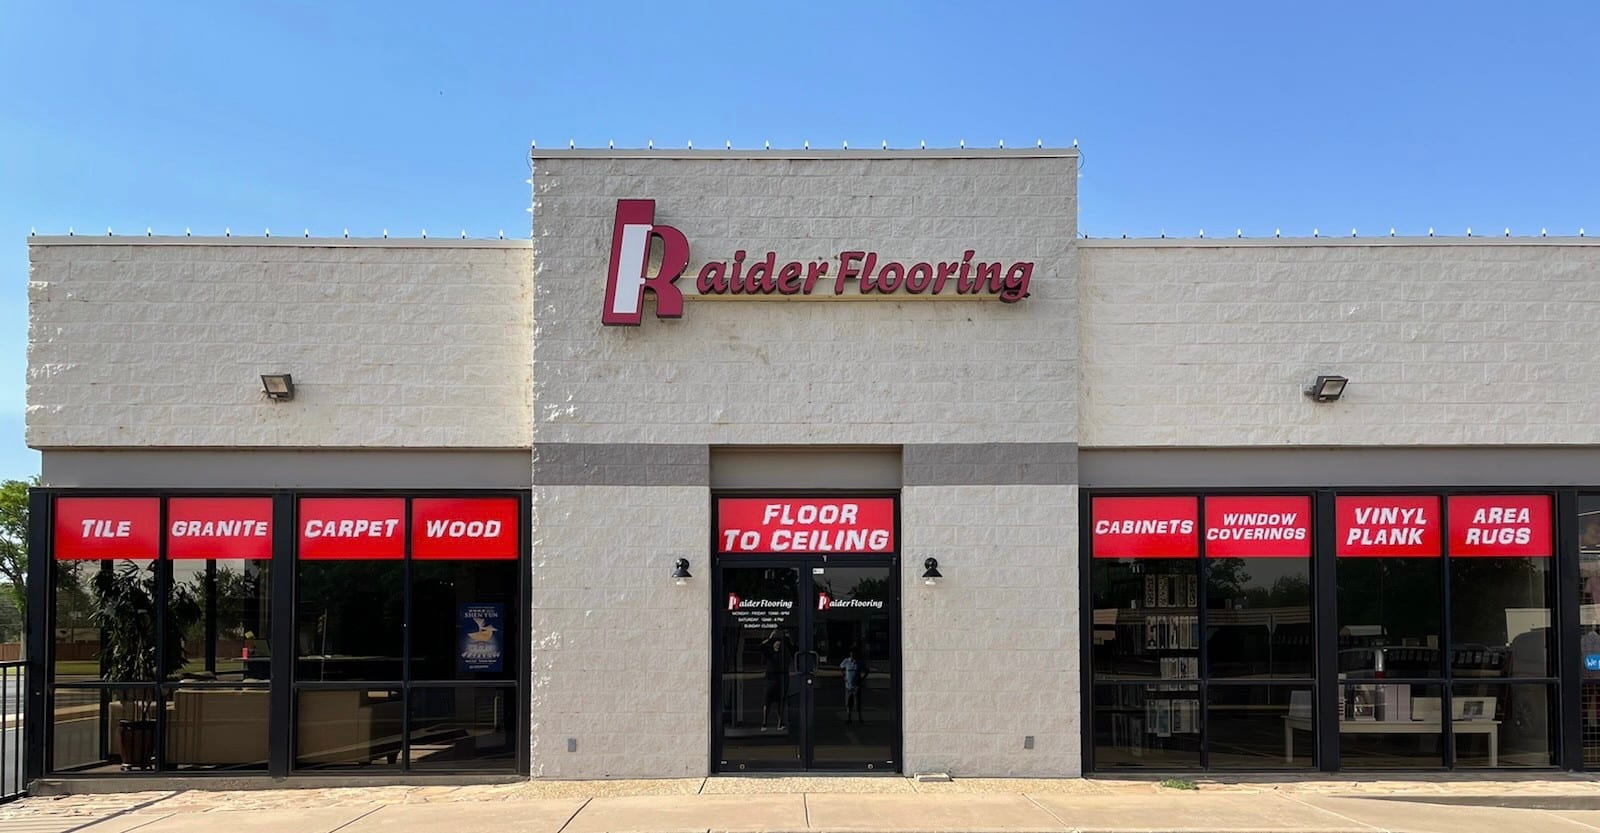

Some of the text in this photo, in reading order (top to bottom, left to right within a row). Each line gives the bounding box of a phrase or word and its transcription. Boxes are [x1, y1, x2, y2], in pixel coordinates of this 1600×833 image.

[601, 198, 1034, 327] Raider Flooring
[762, 503, 858, 525] FLOOR
[1223, 512, 1297, 526] WINDOW
[1355, 507, 1427, 525] VINYL
[1473, 507, 1530, 524] AREA
[81, 519, 132, 538] TILE
[171, 519, 268, 538] GRANITE
[304, 518, 399, 539] CARPET
[426, 519, 502, 539] WOOD
[1095, 518, 1194, 535] CABINETS
[1206, 527, 1306, 541] COVERINGS
[723, 528, 890, 552] TO CEILING
[1346, 527, 1424, 546] PLANK
[1466, 527, 1531, 545] RUGS
[728, 592, 793, 610] Raider Flooring
[818, 592, 883, 610] Raider Flooring
